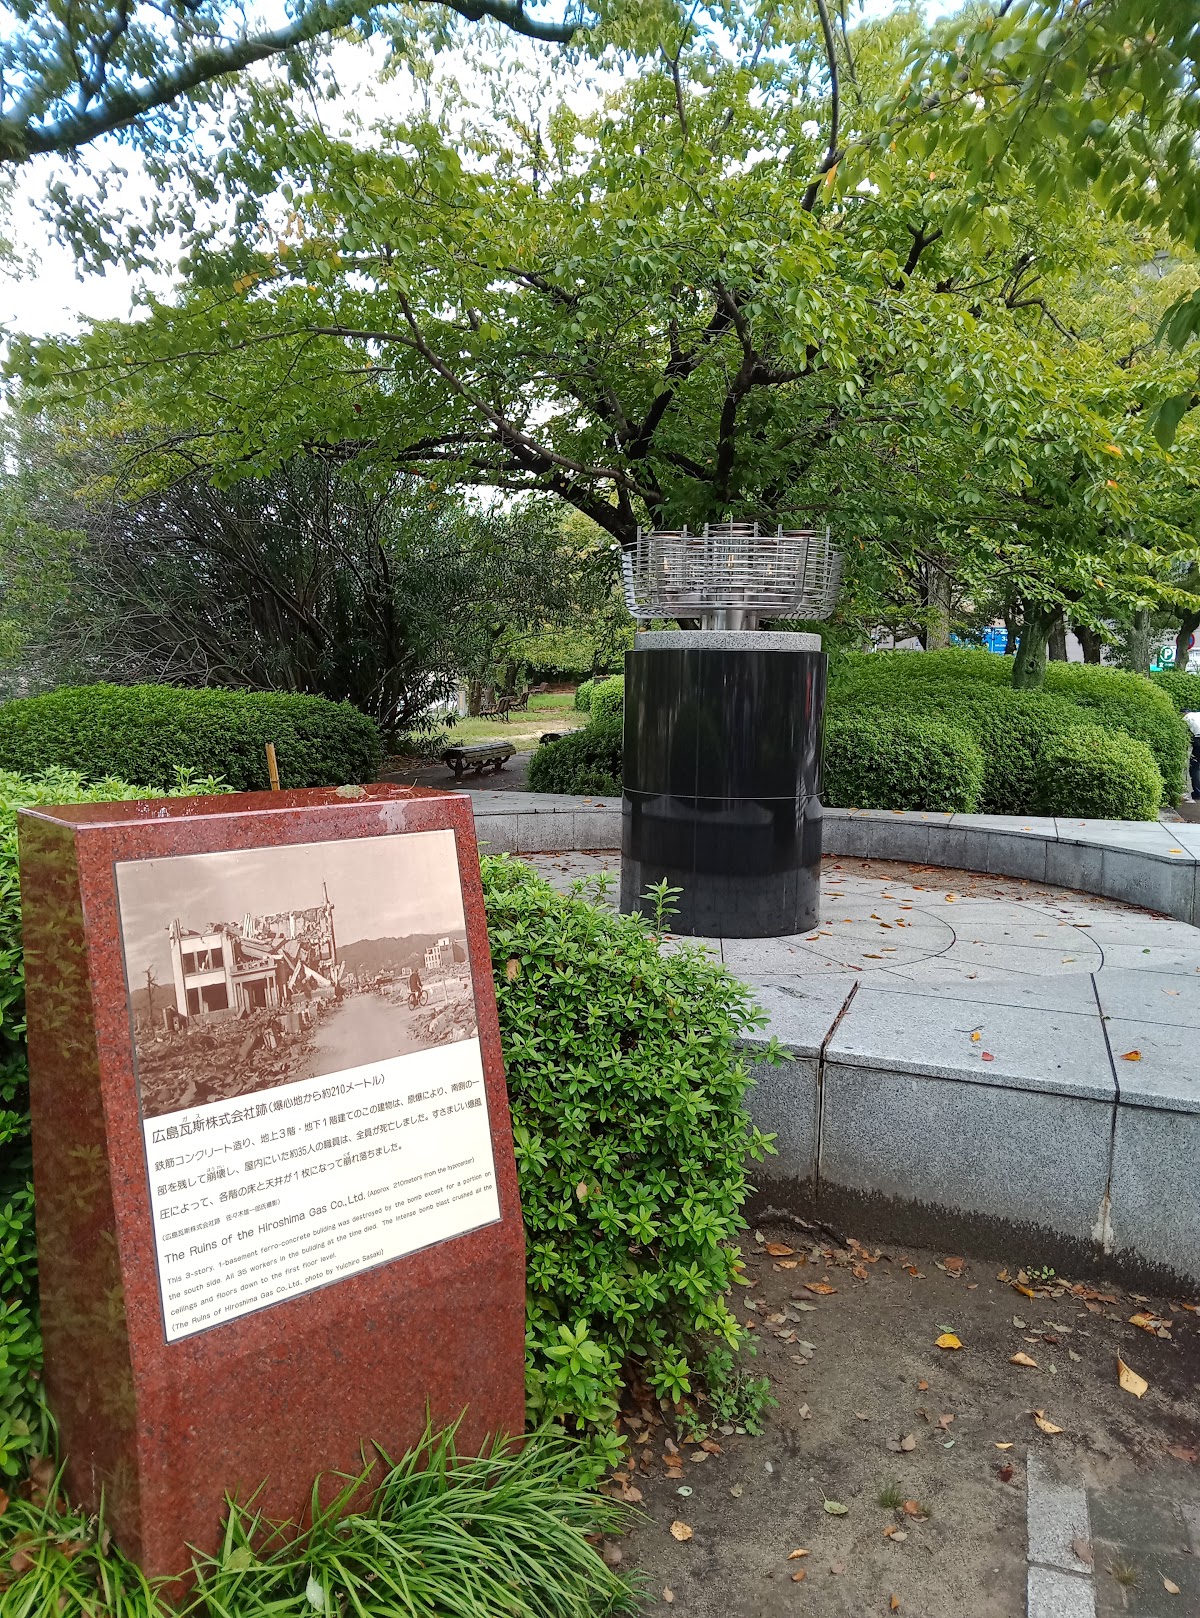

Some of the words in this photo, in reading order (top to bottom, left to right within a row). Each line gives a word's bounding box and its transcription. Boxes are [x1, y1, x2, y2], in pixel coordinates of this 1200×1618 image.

[164, 1251, 185, 1264] The
[189, 1240, 218, 1256] Ruins
[221, 1233, 233, 1246] of
[237, 1229, 254, 1241] the
[258, 1212, 306, 1234] Hiroshima
[308, 1205, 327, 1217] Gas
[423, 1170, 437, 1179] from
[167, 1275, 182, 1285] This
[218, 1249, 258, 1268] 1-basement
[260, 1232, 311, 1253] ferro-concrete
[312, 1223, 337, 1236] building
[337, 1218, 350, 1228] was
[352, 1207, 382, 1223] destroyed
[384, 1204, 392, 1212] by
[394, 1200, 405, 1208] the
[407, 1194, 423, 1204] bomb
[424, 1187, 444, 1198] except
[462, 1174, 482, 1185] portion
[168, 1291, 181, 1301] the
[183, 1284, 204, 1296] south
[206, 1277, 222, 1288] side.
[225, 1272, 235, 1281] All
[237, 1268, 248, 1277] 35
[249, 1258, 278, 1272] workers
[288, 1251, 300, 1259] the
[301, 1241, 326, 1255] building
[327, 1238, 335, 1246] at
[336, 1234, 347, 1242] the
[348, 1229, 362, 1238] time
[382, 1218, 393, 1226] The
[395, 1210, 417, 1221] intense
[418, 1204, 434, 1214] bomb
[435, 1198, 450, 1208] blast
[451, 1190, 474, 1202] crushed
[483, 1184, 493, 1192] the
[170, 1301, 198, 1316] ceilings
[200, 1295, 214, 1306] and
[216, 1287, 237, 1299] floors
[239, 1280, 258, 1291] down
[271, 1272, 283, 1280] the
[284, 1265, 300, 1275] first
[302, 1258, 318, 1269] floor
[172, 1322, 189, 1332] (The
[191, 1313, 211, 1324] Ruins
[213, 1307, 222, 1316] of
[224, 1296, 258, 1312] Hiroshima
[260, 1291, 274, 1299] Gas
[304, 1272, 323, 1283] photo
[325, 1268, 334, 1276] by
[335, 1258, 360, 1271] Yuichiro
[362, 1248, 384, 1262] Sasaki)
